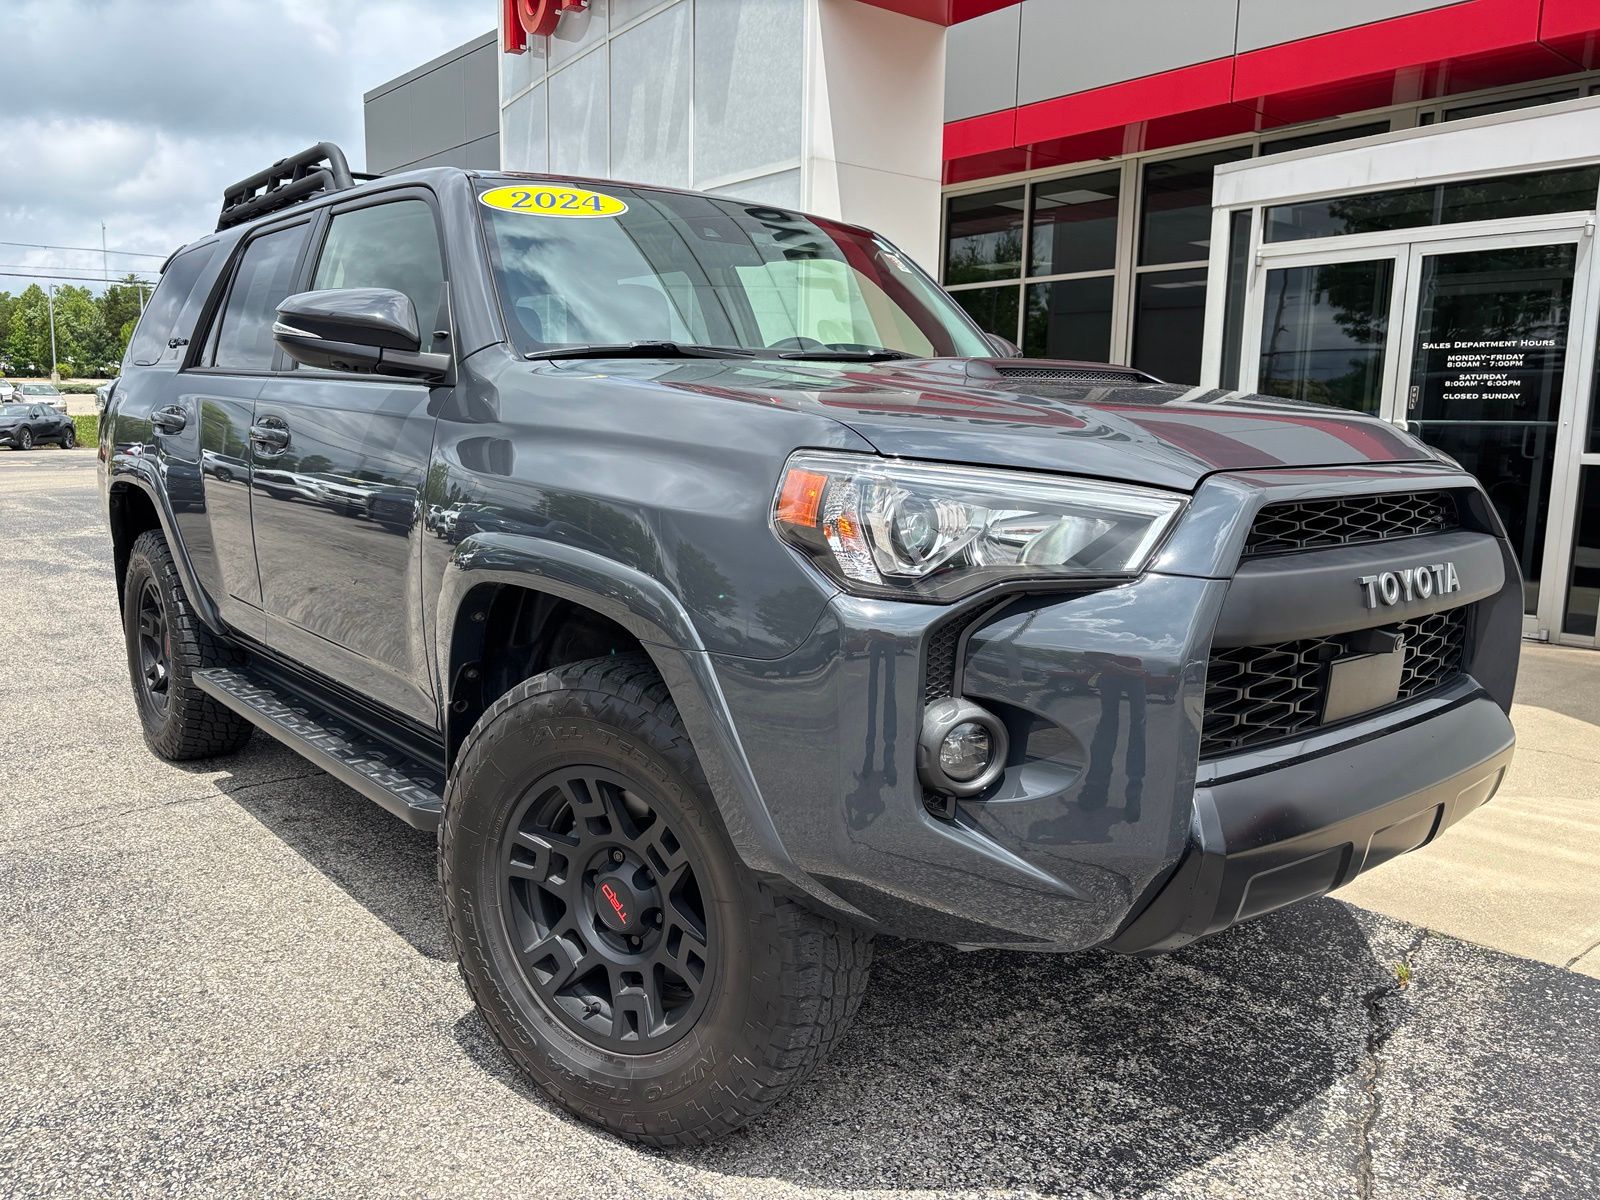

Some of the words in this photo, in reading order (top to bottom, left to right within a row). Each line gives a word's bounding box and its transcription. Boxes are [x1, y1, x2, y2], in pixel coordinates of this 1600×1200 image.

[511, 191, 605, 212] 2024
[1447, 353, 1525, 361] MONDAY-FRIDAY
[1358, 562, 1461, 608] TOYOTA
[601, 883, 627, 924] TRD
